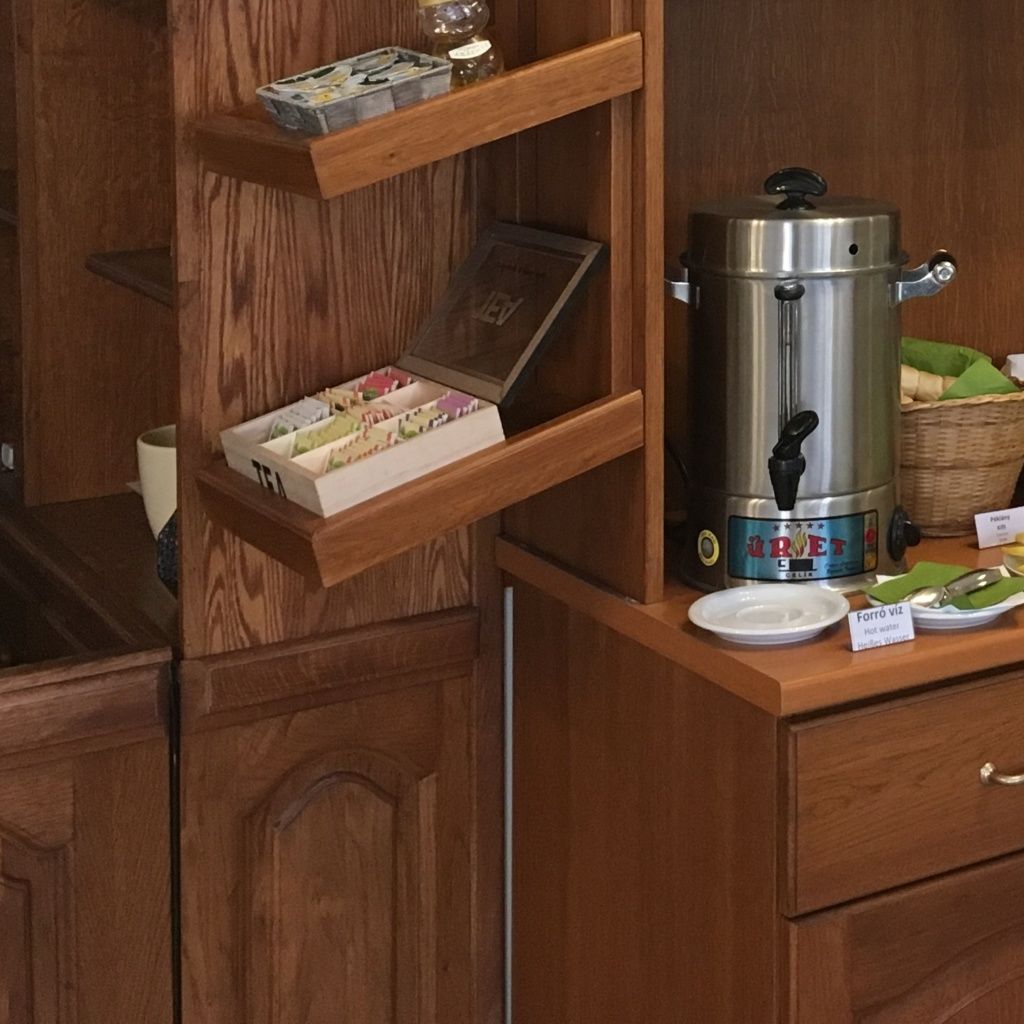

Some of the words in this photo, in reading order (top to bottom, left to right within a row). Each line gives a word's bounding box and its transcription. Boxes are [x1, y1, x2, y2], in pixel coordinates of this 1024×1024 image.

[251, 458, 287, 498] TEA
[857, 606, 886, 623] Forró
[864, 626, 878, 636] Hot
[879, 623, 900, 633] water
